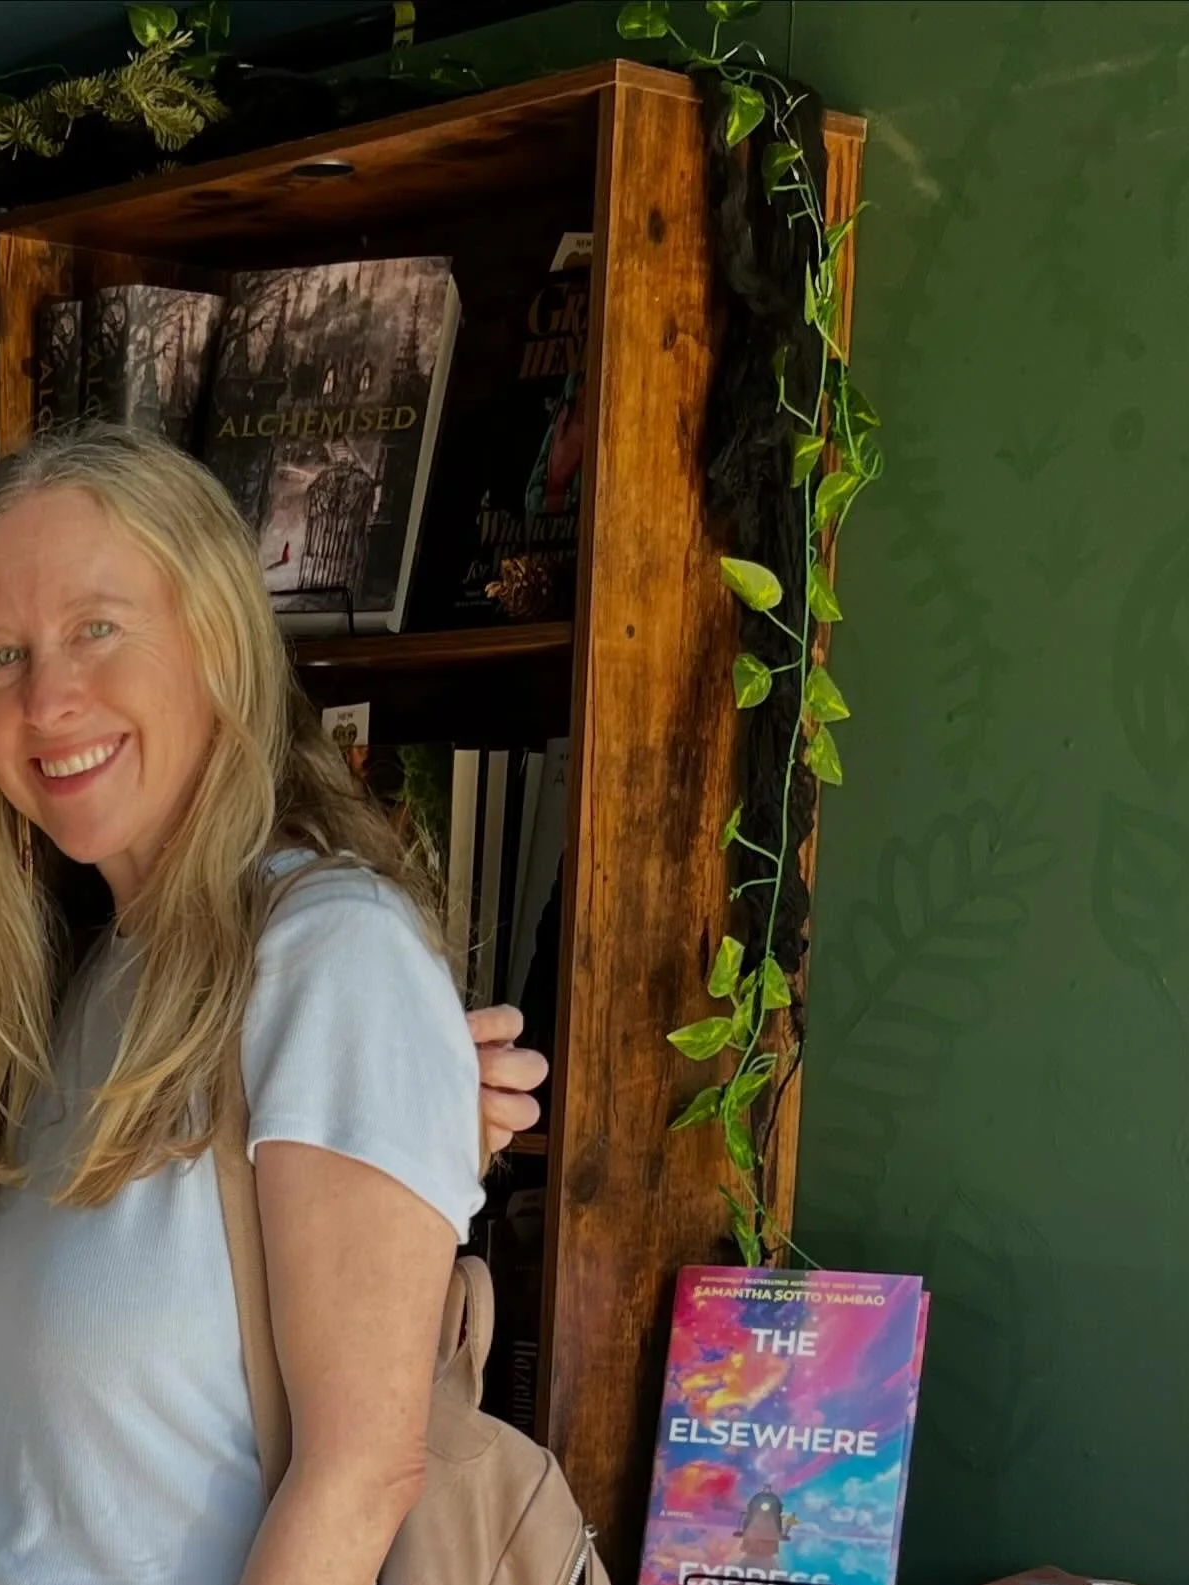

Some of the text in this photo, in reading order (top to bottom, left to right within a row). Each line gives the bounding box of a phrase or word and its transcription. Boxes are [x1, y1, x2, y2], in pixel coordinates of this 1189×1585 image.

[217, 405, 417, 438] ALCHEMISED
[693, 1285, 885, 1306] SAMANTHA SOTTO YAMBAO
[751, 1327, 819, 1357] THE
[668, 1418, 878, 1457] ELSEWHERE
